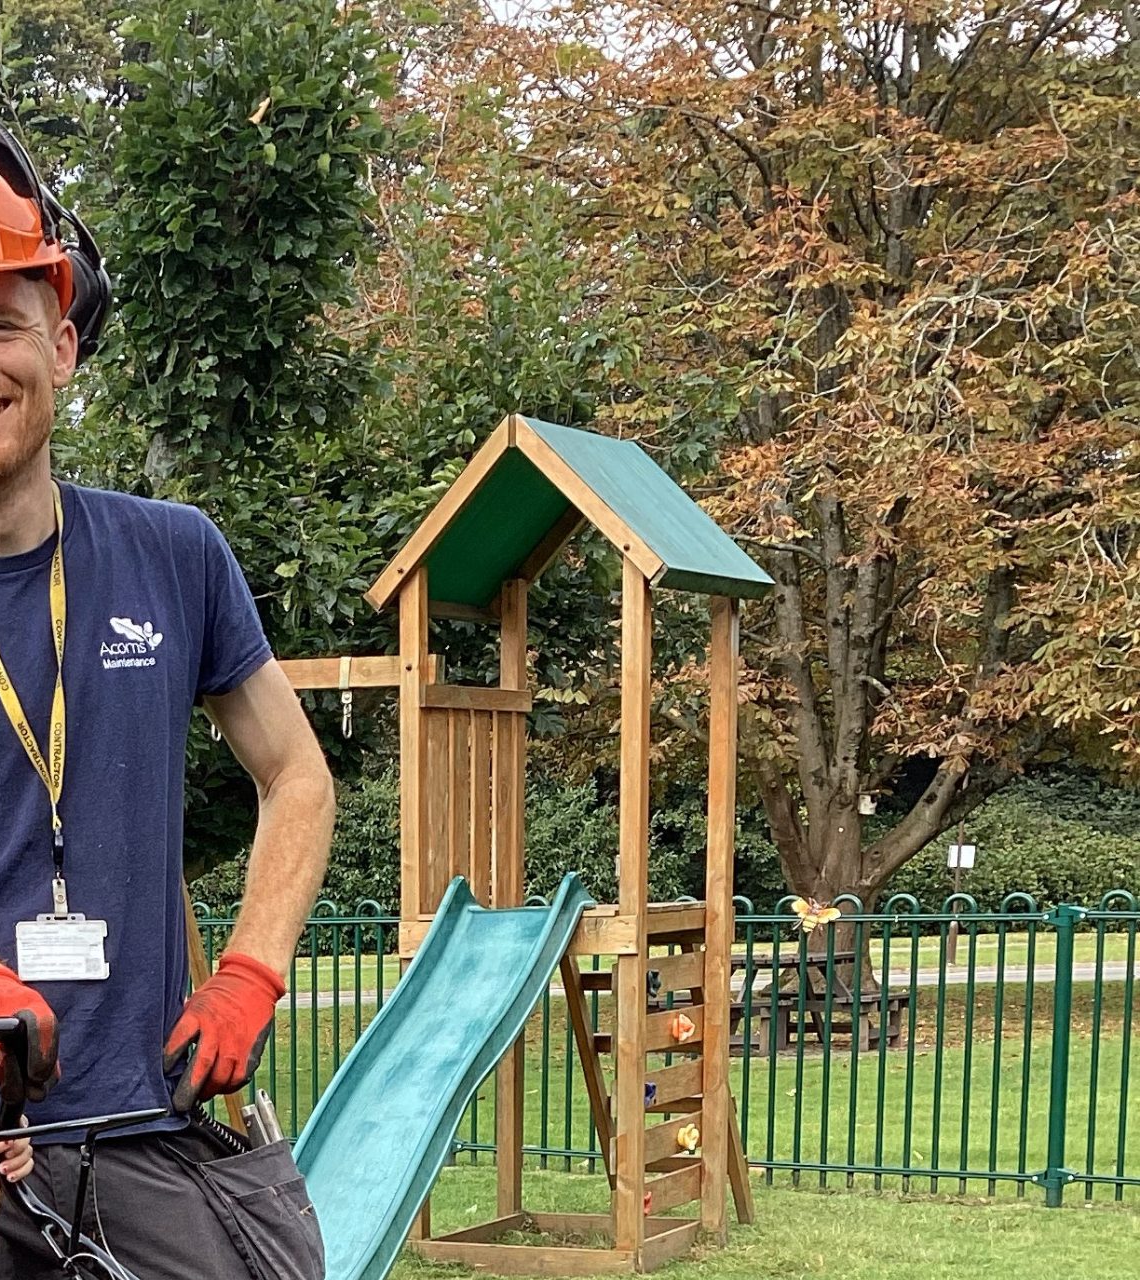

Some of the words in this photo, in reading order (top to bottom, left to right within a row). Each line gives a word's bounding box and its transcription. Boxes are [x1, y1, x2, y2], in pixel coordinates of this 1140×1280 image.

[102, 657, 157, 670] Maintenance
[17, 720, 50, 784] CONTRACTOR
[53, 722, 63, 789] CONTRACTOR
